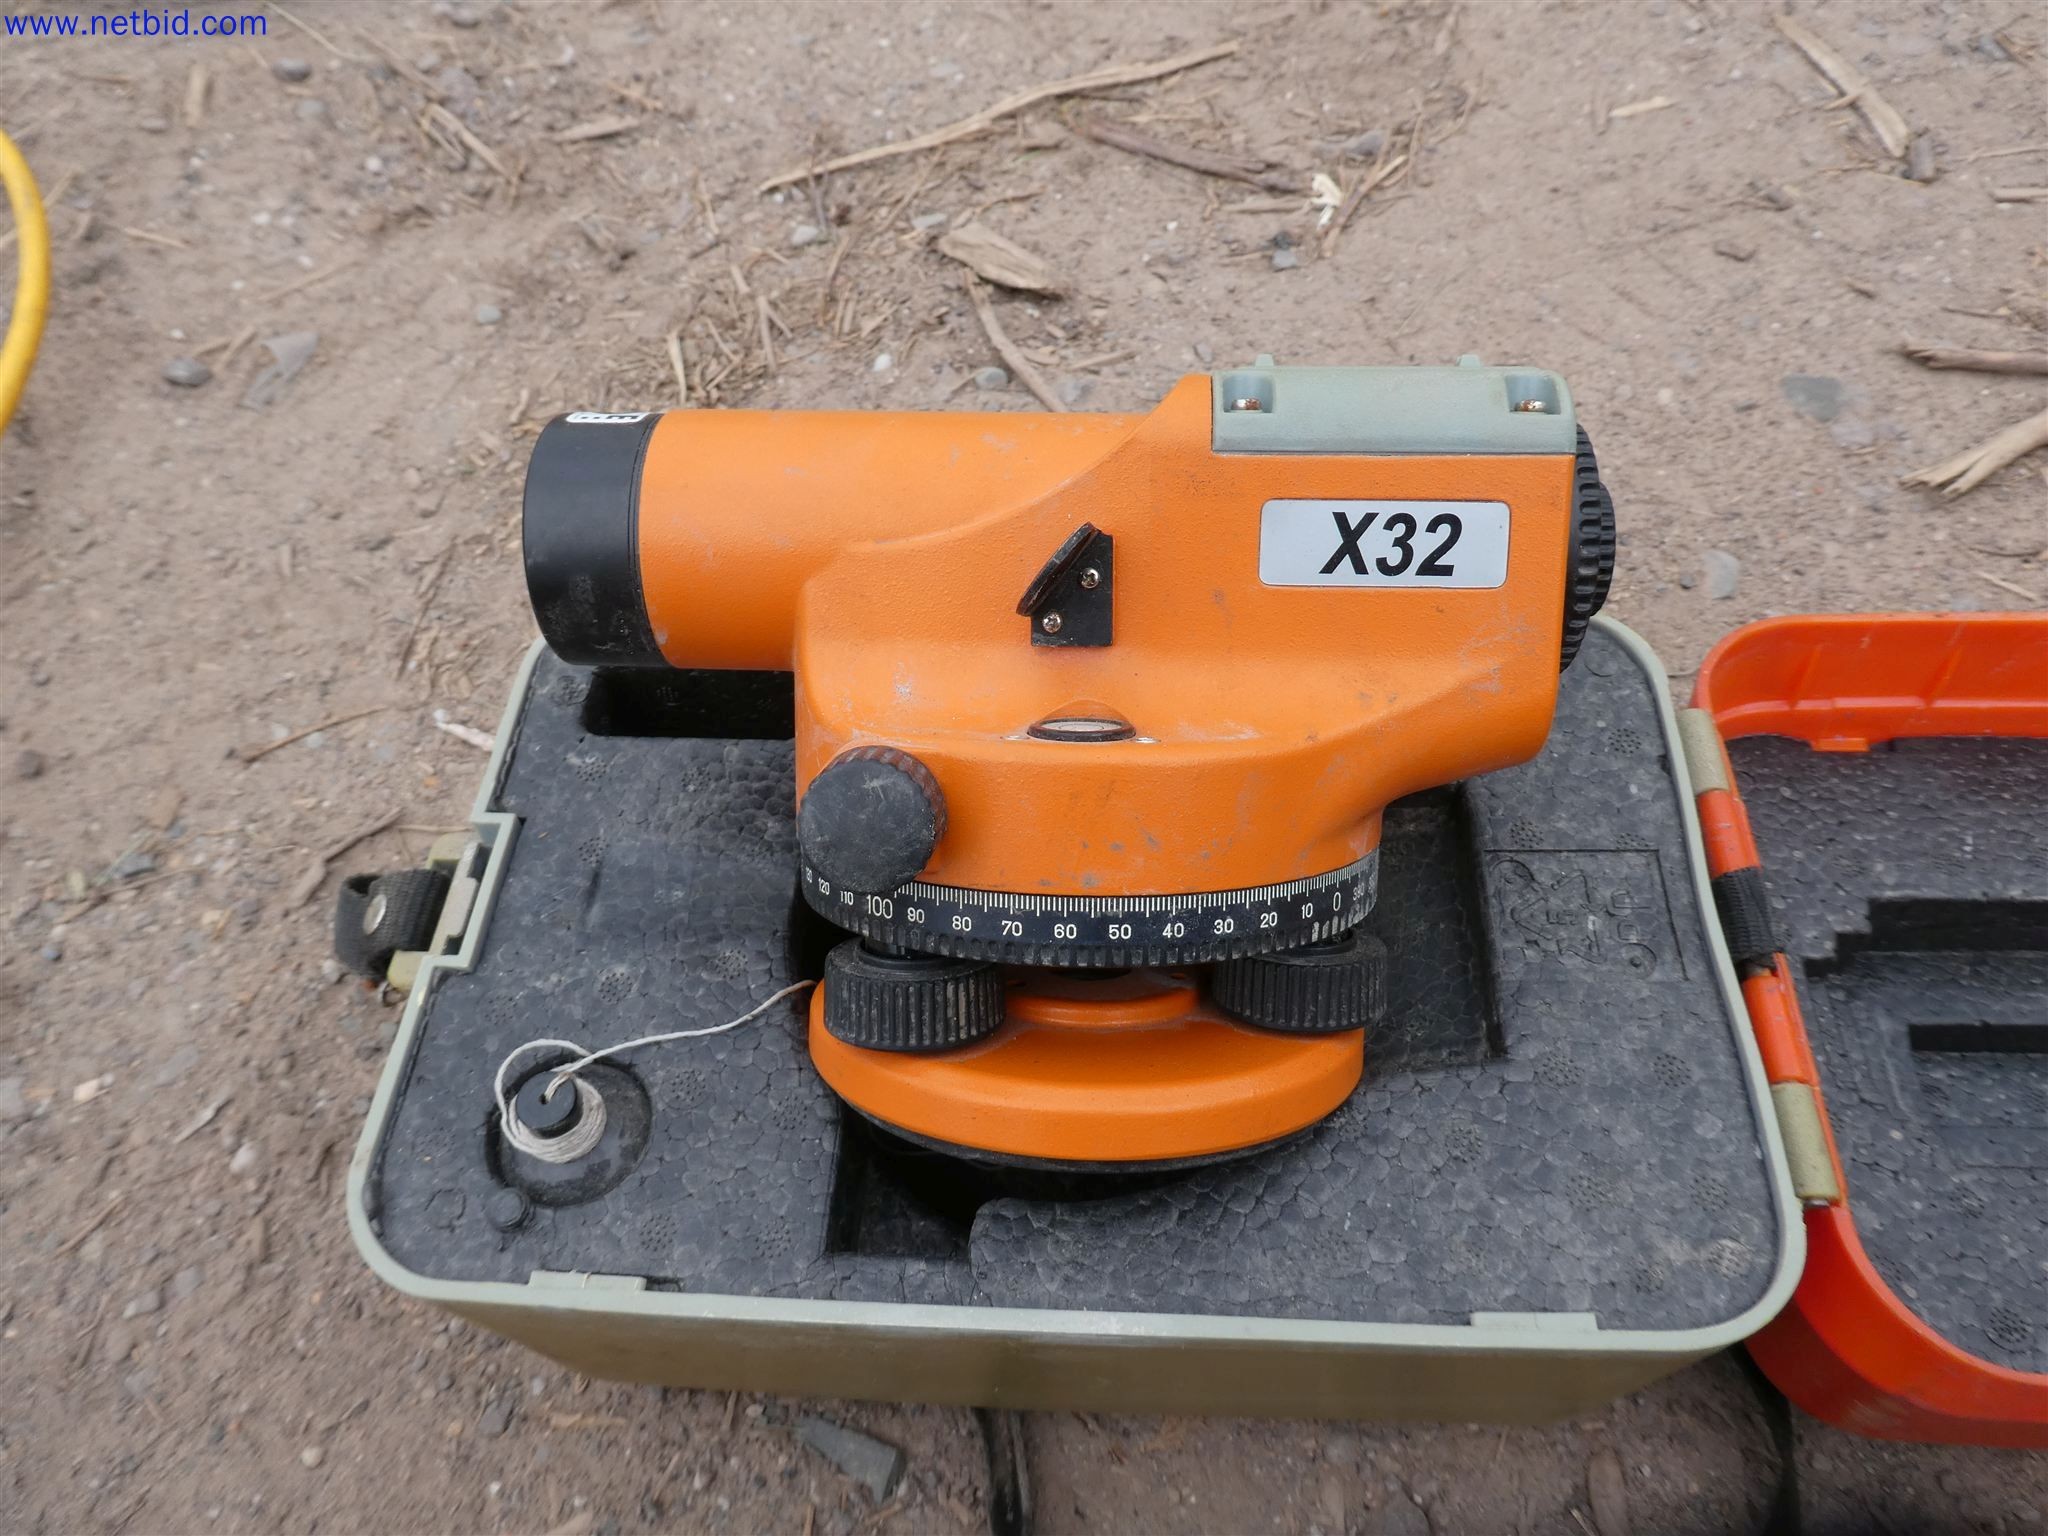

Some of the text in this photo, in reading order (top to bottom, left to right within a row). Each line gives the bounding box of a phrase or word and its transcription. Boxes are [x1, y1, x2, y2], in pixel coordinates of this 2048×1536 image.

[1318, 511, 1463, 577] X32
[818, 877, 830, 895] 120
[840, 891, 854, 906] 110
[866, 894, 893, 919] 100
[907, 907, 925, 924] 90
[952, 916, 972, 931] 80
[1001, 921, 1023, 936] 70
[1054, 924, 1077, 939] 60
[1108, 924, 1132, 939] 50
[1162, 923, 1184, 938] 40
[1213, 919, 1234, 934] 30
[1260, 912, 1278, 928] 20
[1301, 903, 1313, 918] 10
[1333, 892, 1341, 911] 0
